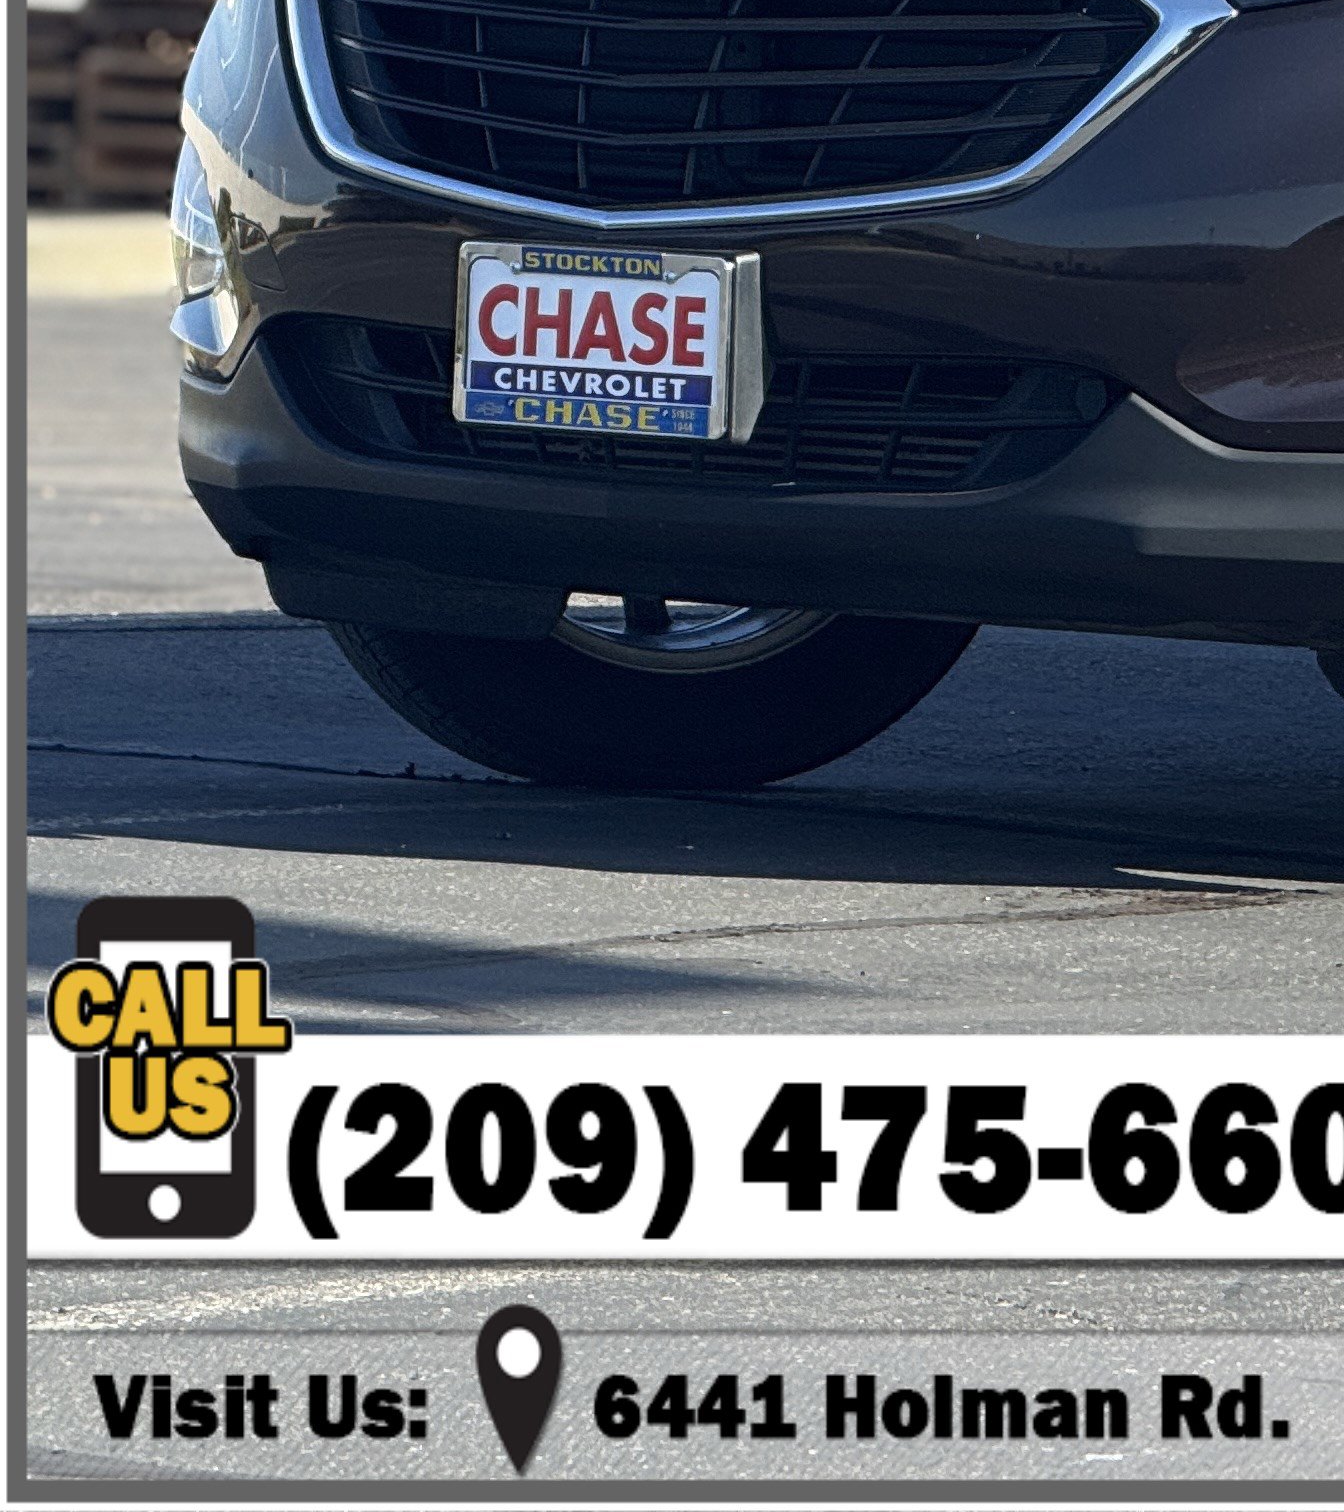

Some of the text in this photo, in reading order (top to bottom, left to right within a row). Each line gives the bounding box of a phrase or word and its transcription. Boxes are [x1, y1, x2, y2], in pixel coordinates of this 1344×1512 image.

[525, 251, 661, 277] STOCKTON
[478, 283, 706, 367] CHASE
[494, 367, 686, 401] CHEVROLET
[514, 397, 662, 432] CHASE
